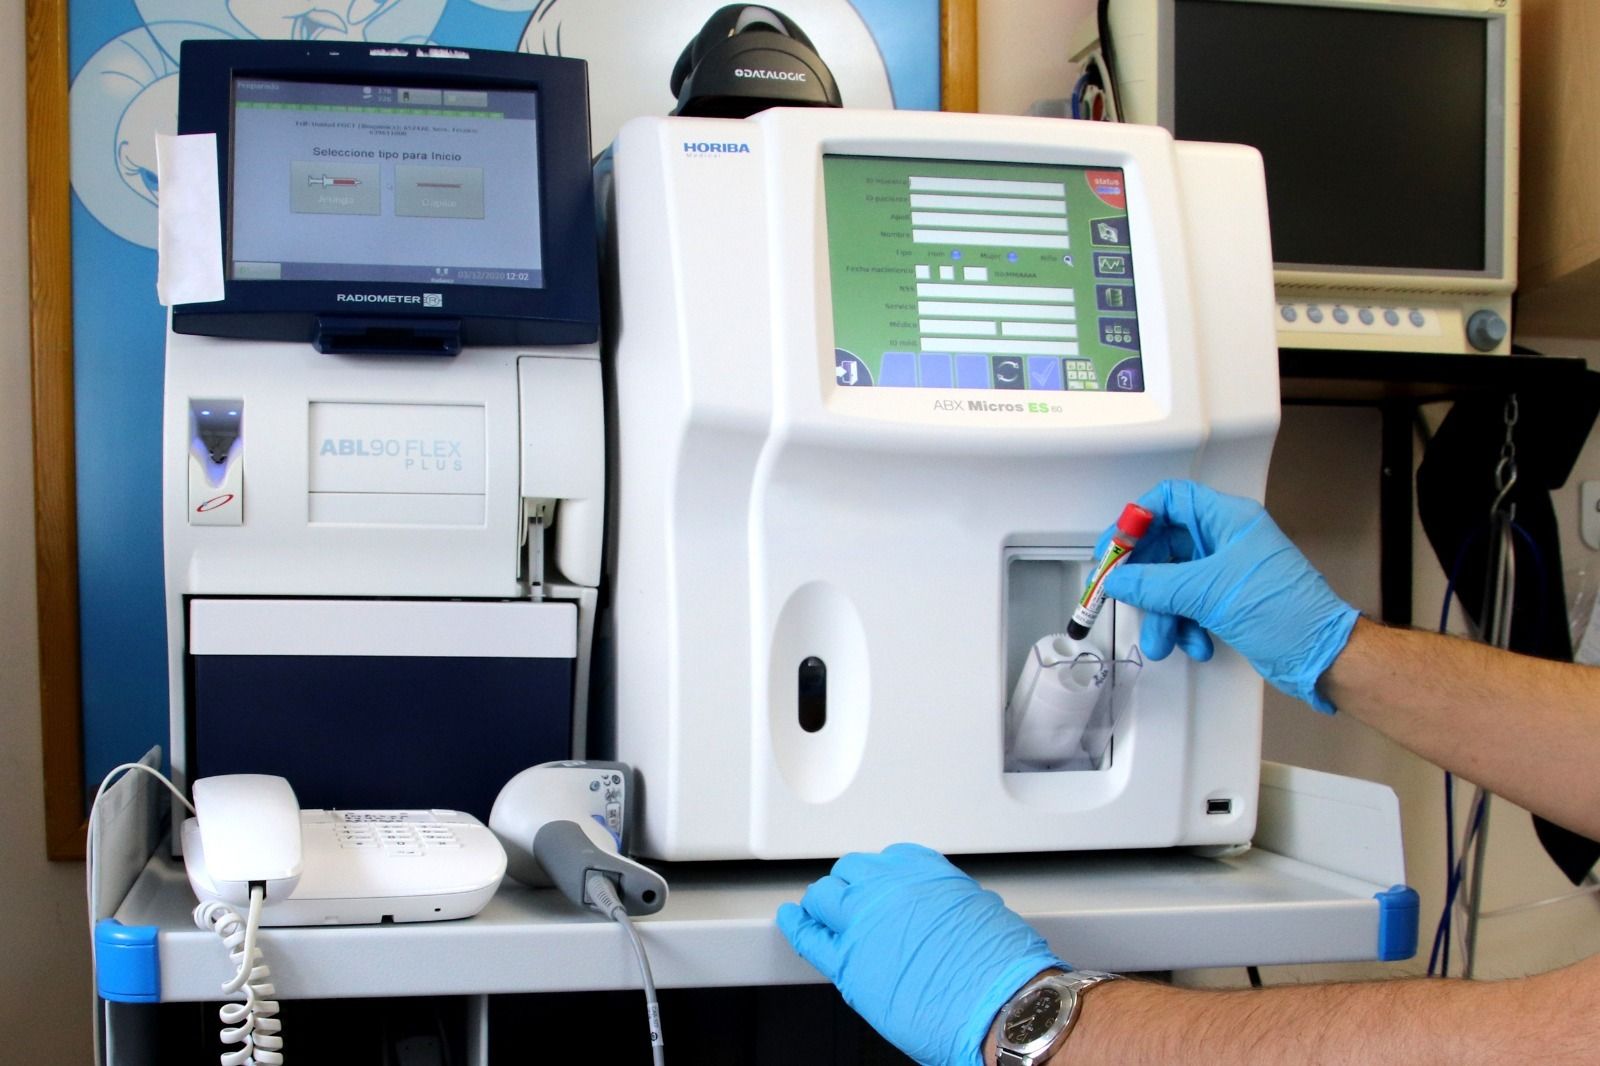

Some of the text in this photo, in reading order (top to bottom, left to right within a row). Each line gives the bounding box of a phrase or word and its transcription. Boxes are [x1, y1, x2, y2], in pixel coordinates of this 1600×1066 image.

[744, 69, 806, 82] DATALOGIC
[312, 147, 462, 162] Seleccione tipo para Inicio
[683, 142, 750, 153] HORIBA
[336, 293, 421, 305] RADIOMETER
[933, 399, 965, 411] ABX
[967, 400, 1025, 412] Micros
[1027, 402, 1050, 414] ES
[319, 439, 462, 458] ABL90 FLEX
[405, 458, 463, 472] PLUS
